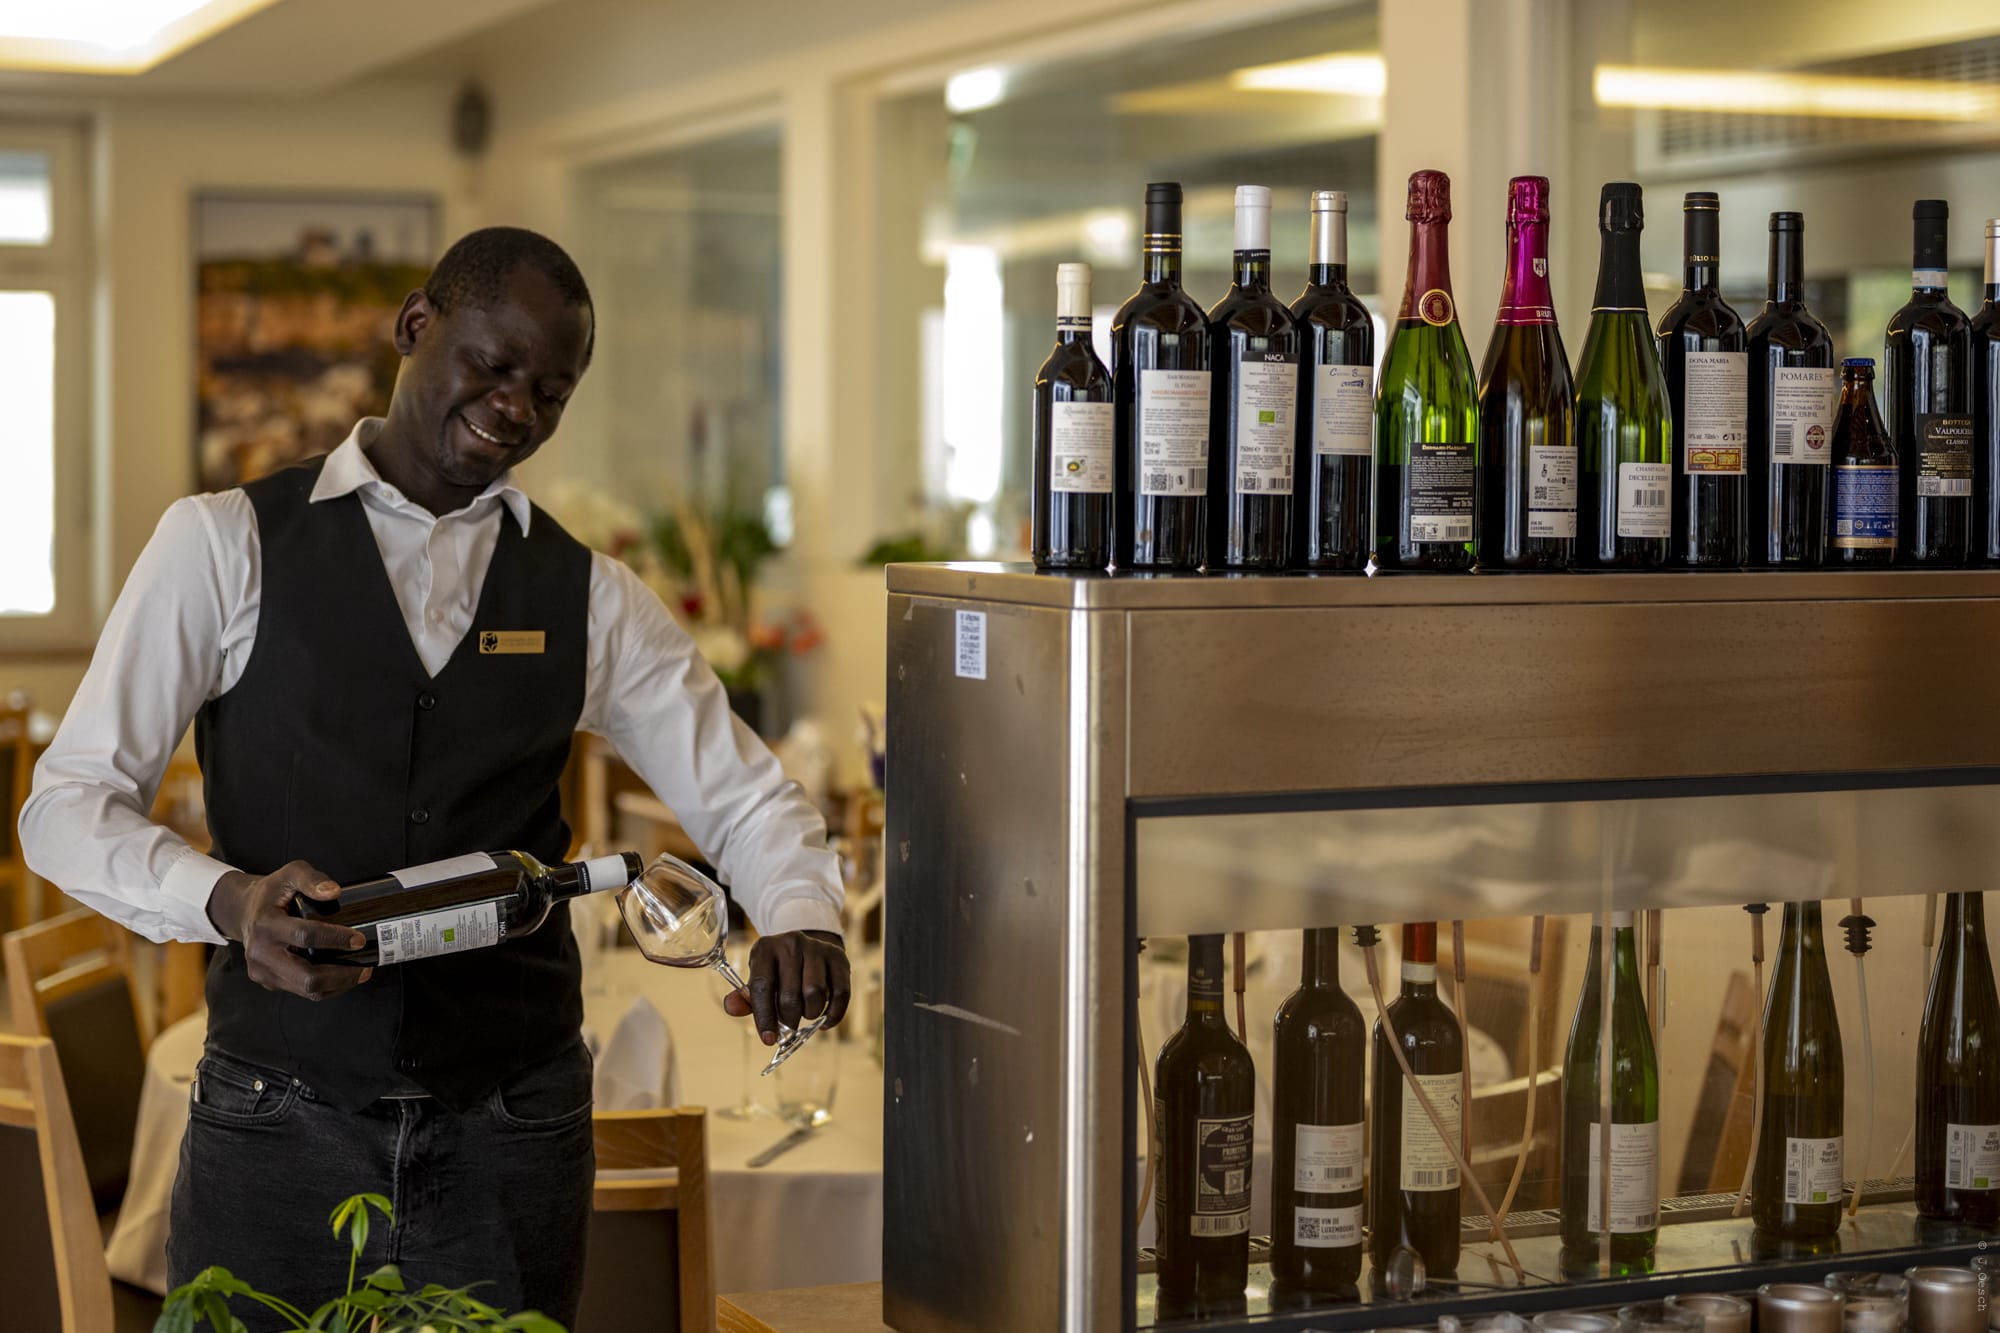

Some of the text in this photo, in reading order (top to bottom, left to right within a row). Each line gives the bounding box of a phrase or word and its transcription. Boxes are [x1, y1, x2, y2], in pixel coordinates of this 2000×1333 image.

[1264, 353, 1285, 361] NACA
[1780, 372, 1824, 381] POMARES
[1321, 1217, 1331, 1225] VIN
